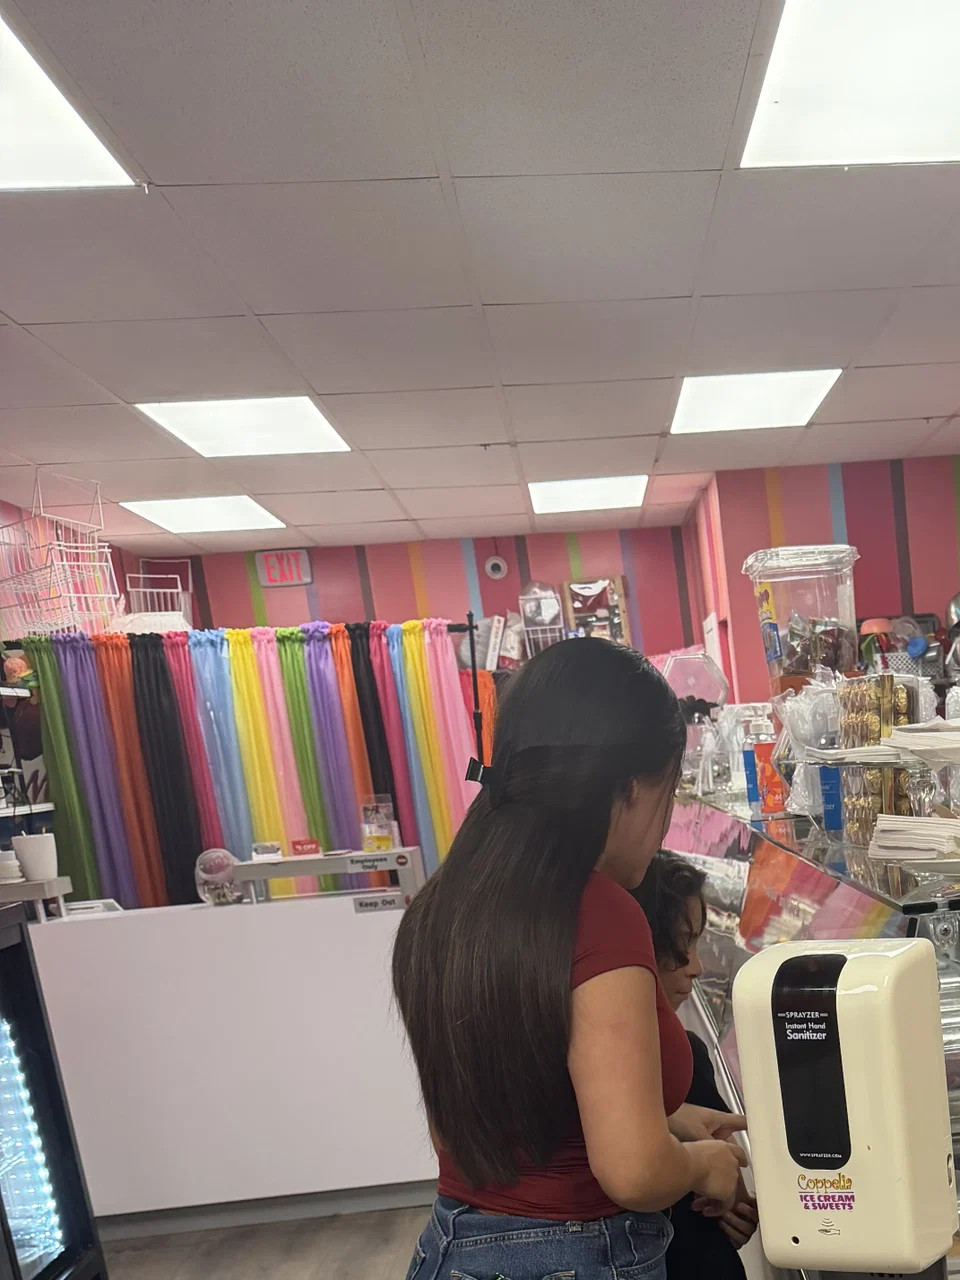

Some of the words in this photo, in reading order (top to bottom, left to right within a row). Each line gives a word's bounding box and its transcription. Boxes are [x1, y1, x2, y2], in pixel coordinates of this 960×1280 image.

[263, 551, 303, 584] EXIT
[350, 856, 388, 866] Employees
[358, 900, 379, 909] Keep
[381, 898, 397, 908] Out
[785, 1011, 820, 1019] SPRAYZER
[786, 1029, 827, 1040] Sanitizer
[797, 1172, 853, 1194] Coppelia
[799, 1194, 815, 1203] ICE
[817, 1194, 855, 1203] CREAM
[811, 1203, 854, 1211] SWEETS
